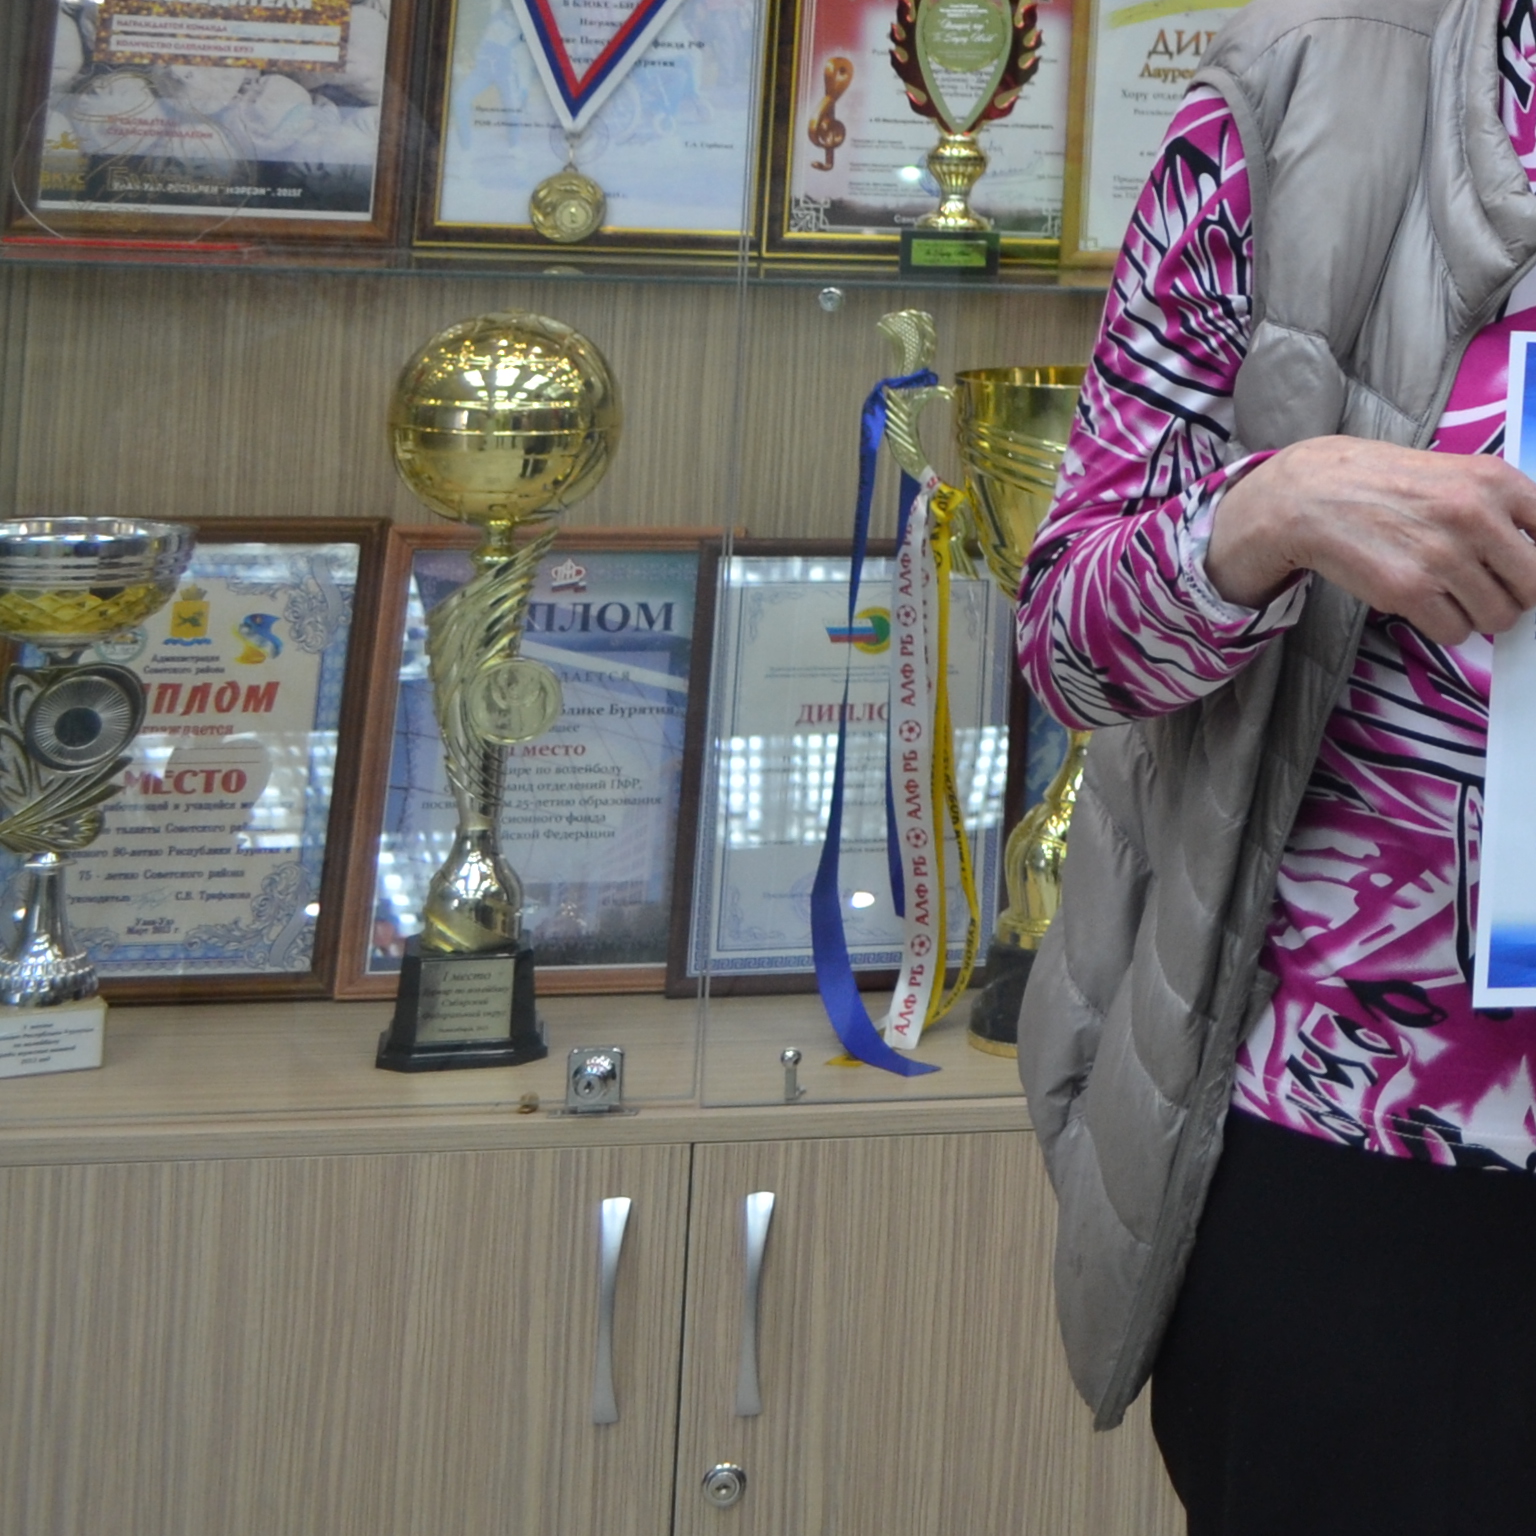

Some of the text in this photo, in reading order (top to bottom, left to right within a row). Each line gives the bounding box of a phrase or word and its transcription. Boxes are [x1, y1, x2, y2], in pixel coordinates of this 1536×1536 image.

[899, 634, 917, 707] АЛФ РБ
[522, 744, 587, 757] место
[902, 749, 922, 820] АЛФ РБ
[913, 855, 930, 926] АЛФ РБ
[893, 964, 926, 1036] АЛФ РБ
